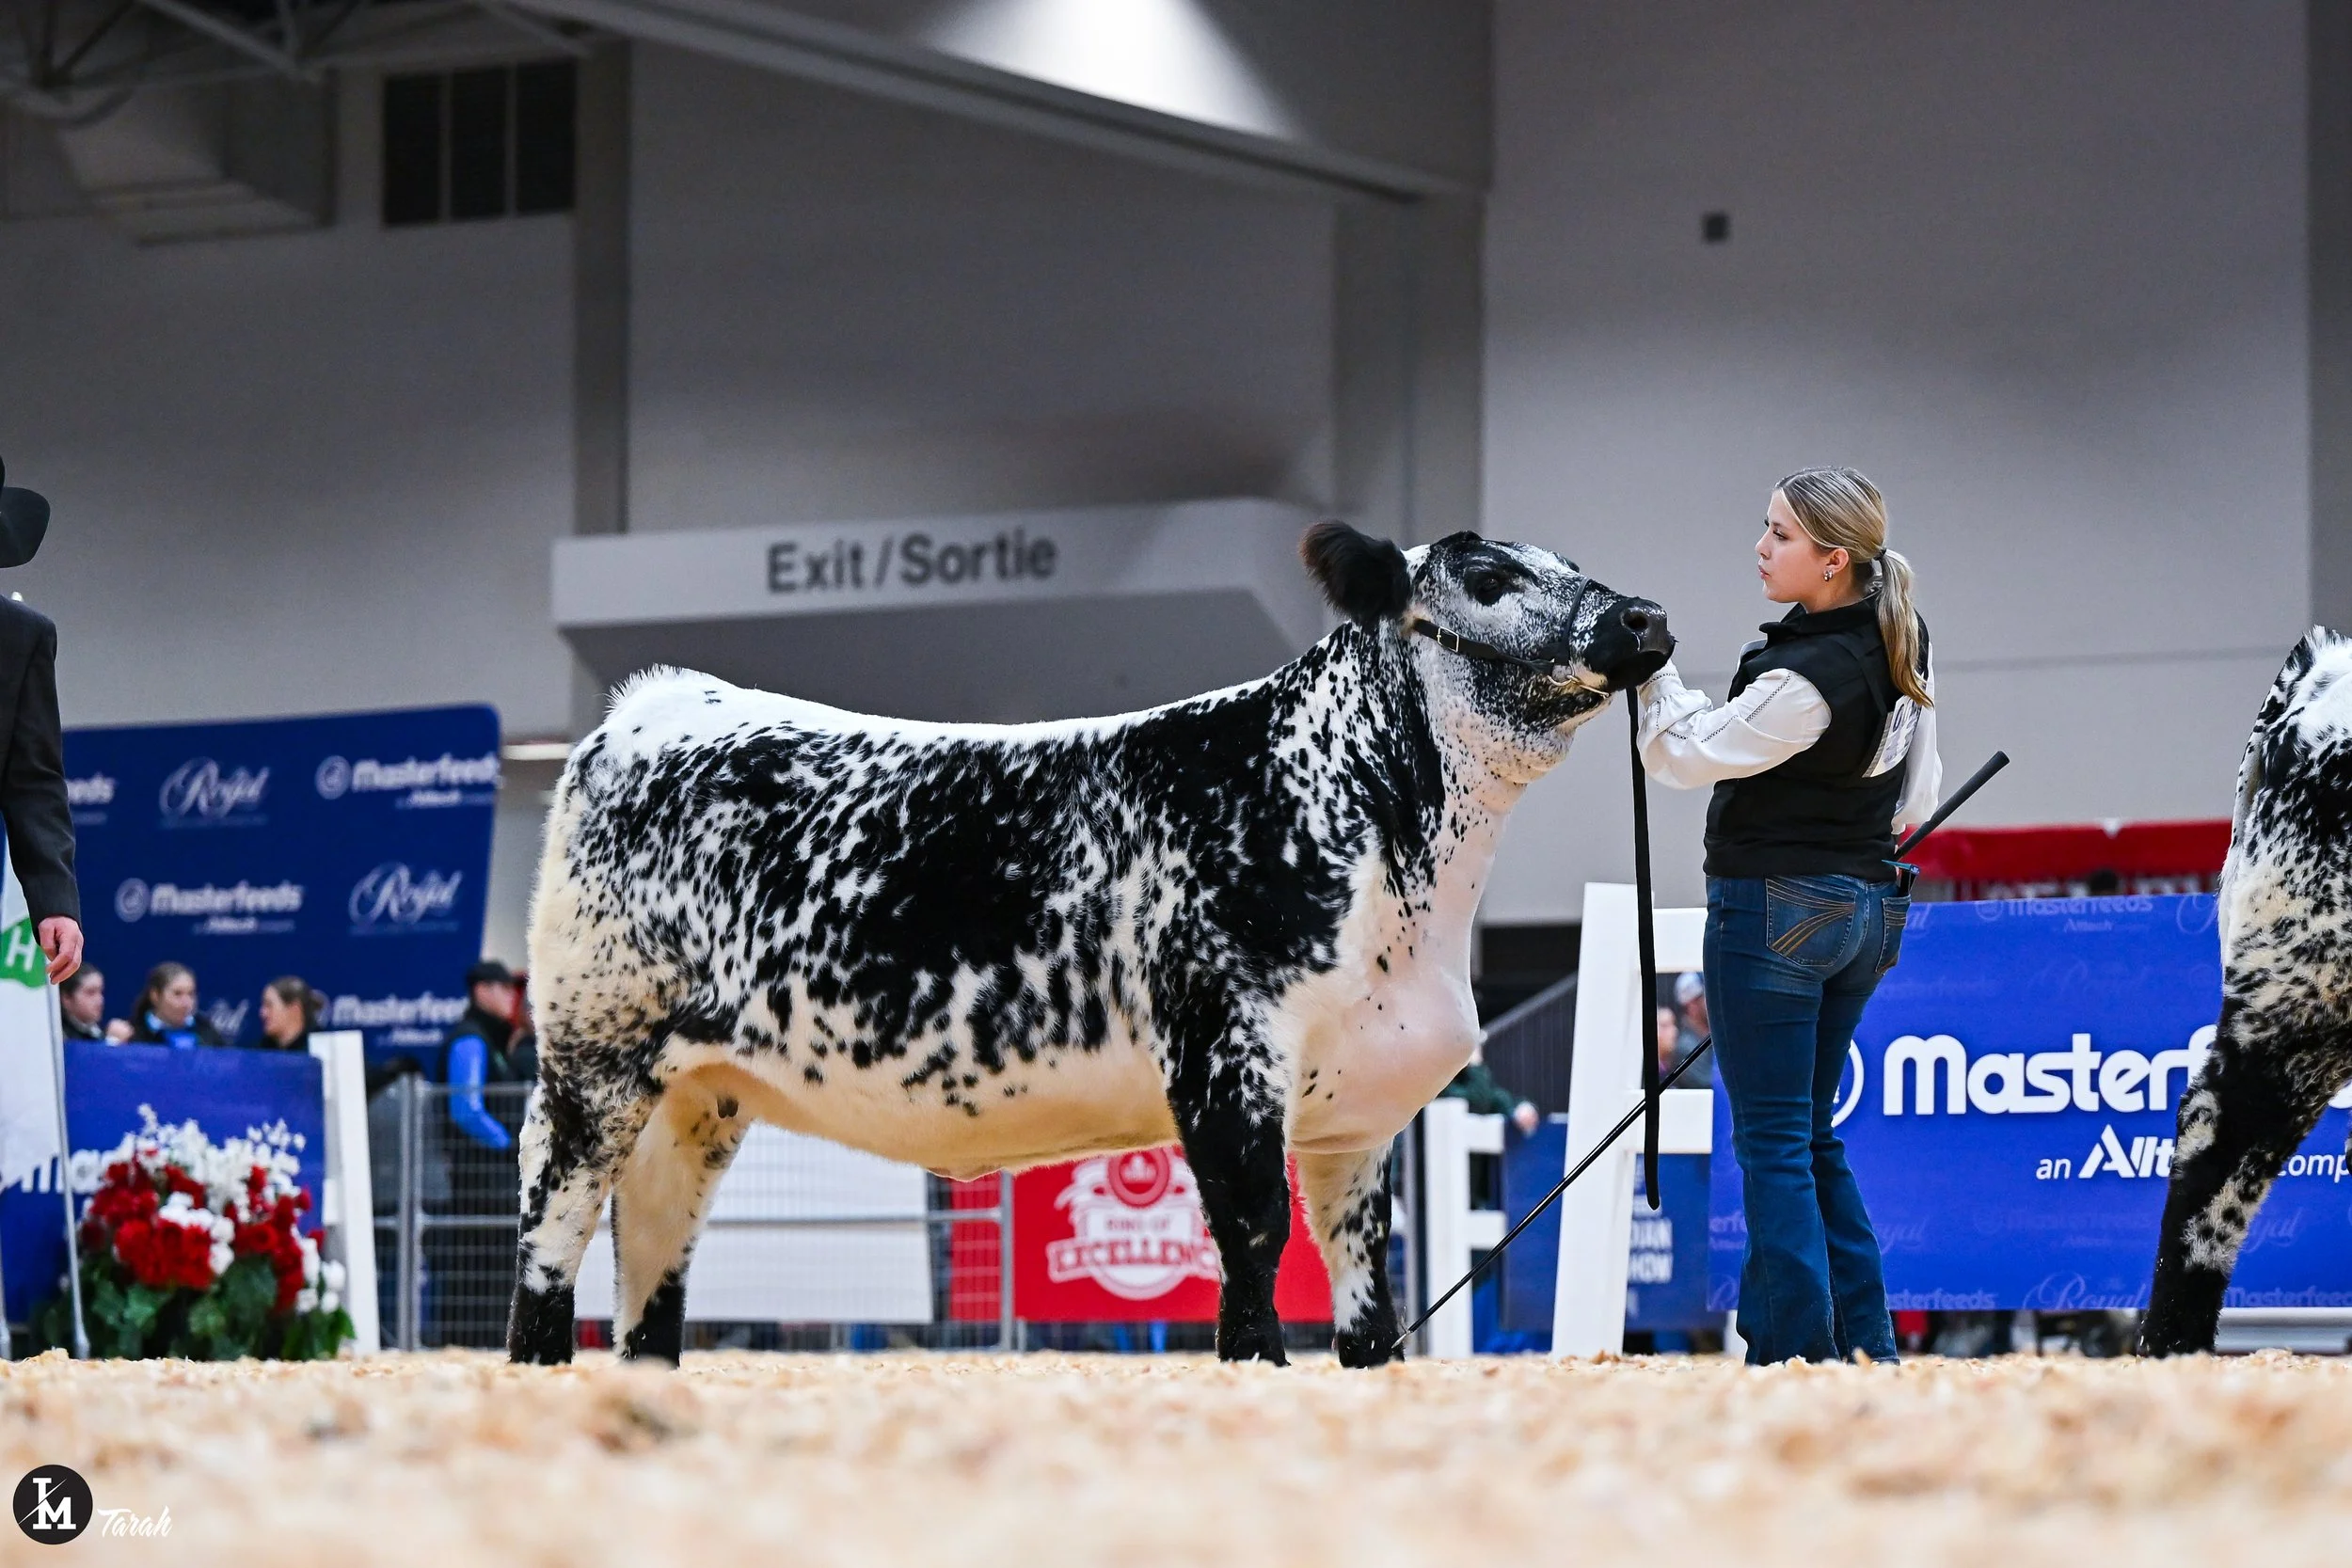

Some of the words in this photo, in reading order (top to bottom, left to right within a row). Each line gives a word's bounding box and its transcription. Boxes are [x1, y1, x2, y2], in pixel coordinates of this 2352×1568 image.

[1883, 1024, 2217, 1115] Masterf
[2036, 1158, 2071, 1180] an
[2078, 1124, 2175, 1179] Allt
